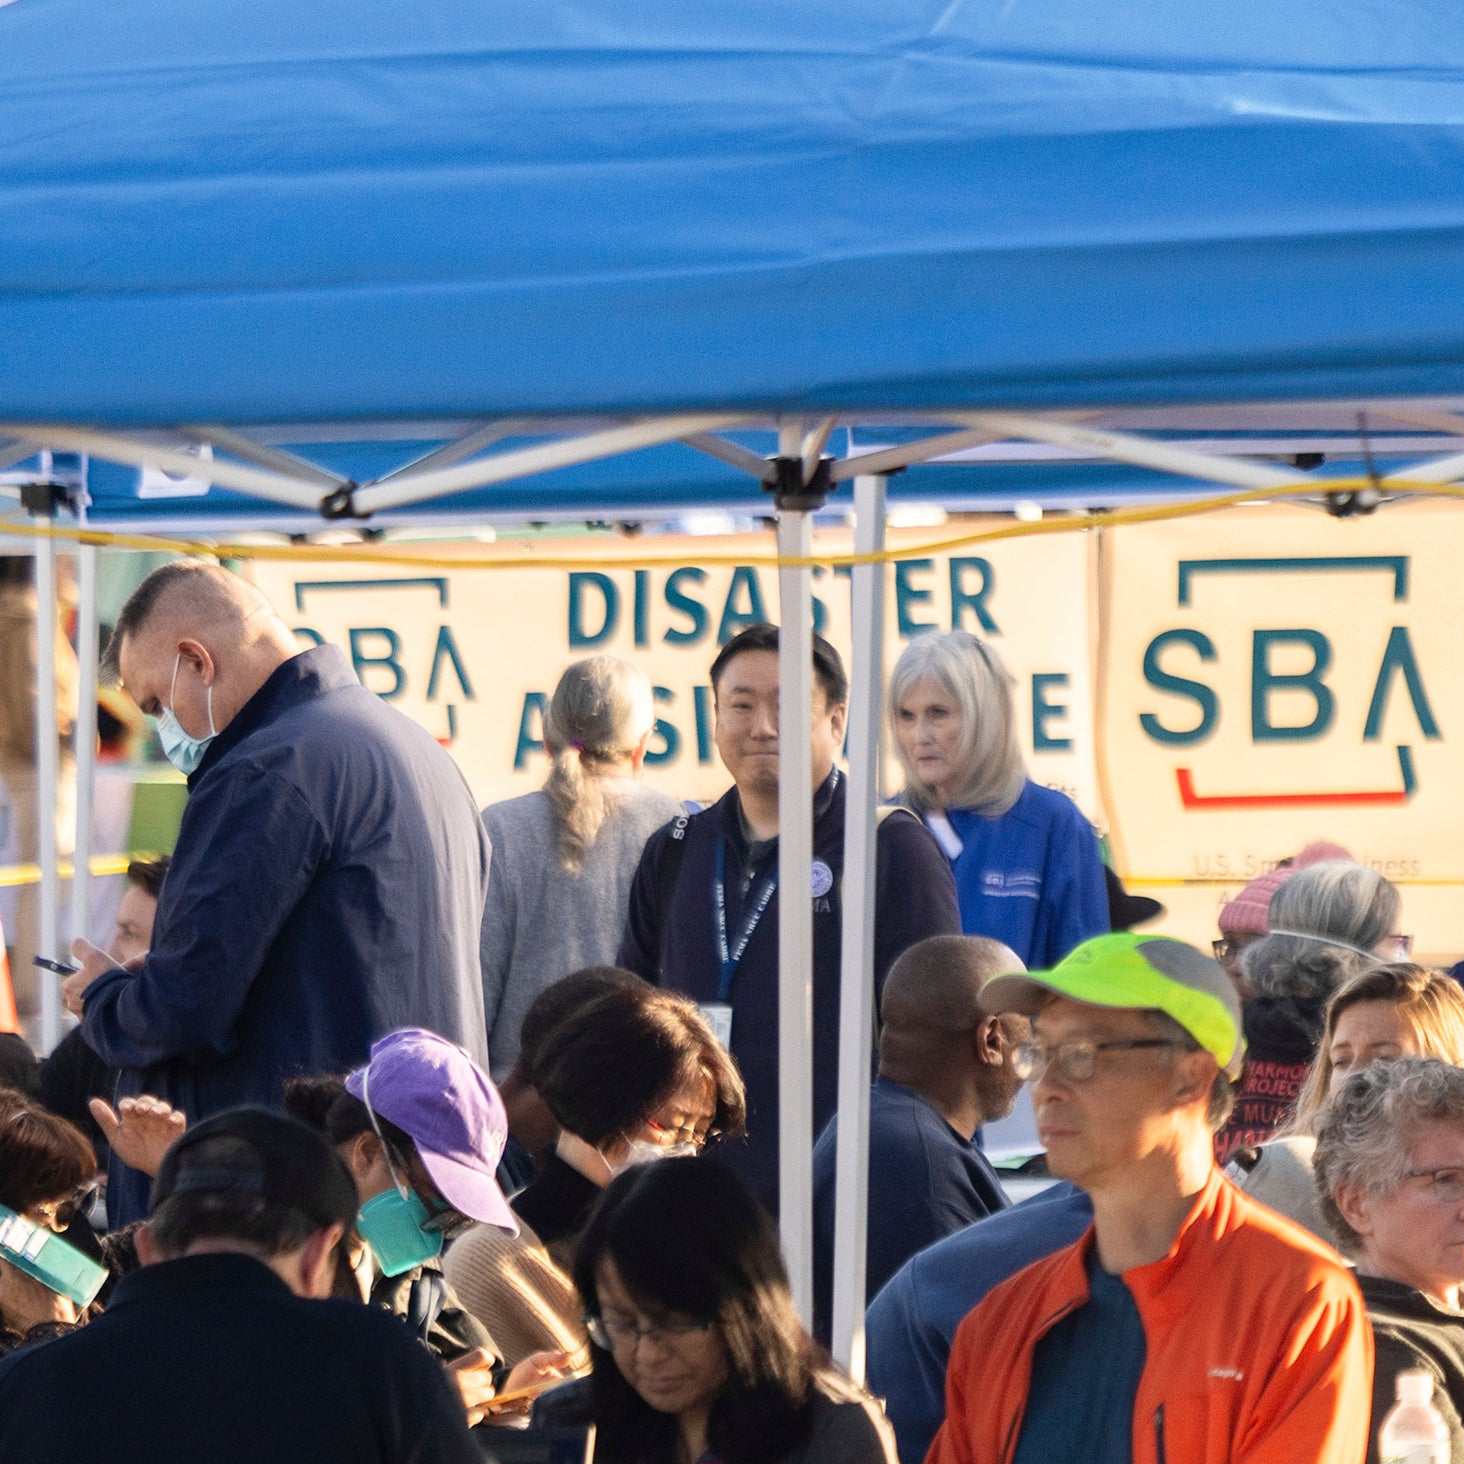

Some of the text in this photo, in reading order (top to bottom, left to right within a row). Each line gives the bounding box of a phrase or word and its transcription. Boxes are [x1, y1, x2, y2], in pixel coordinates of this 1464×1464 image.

[567, 556, 1002, 650] DISAER
[291, 624, 476, 702] BA
[1139, 625, 1443, 747] SBA
[1248, 1078, 1300, 1097] ROJEC
